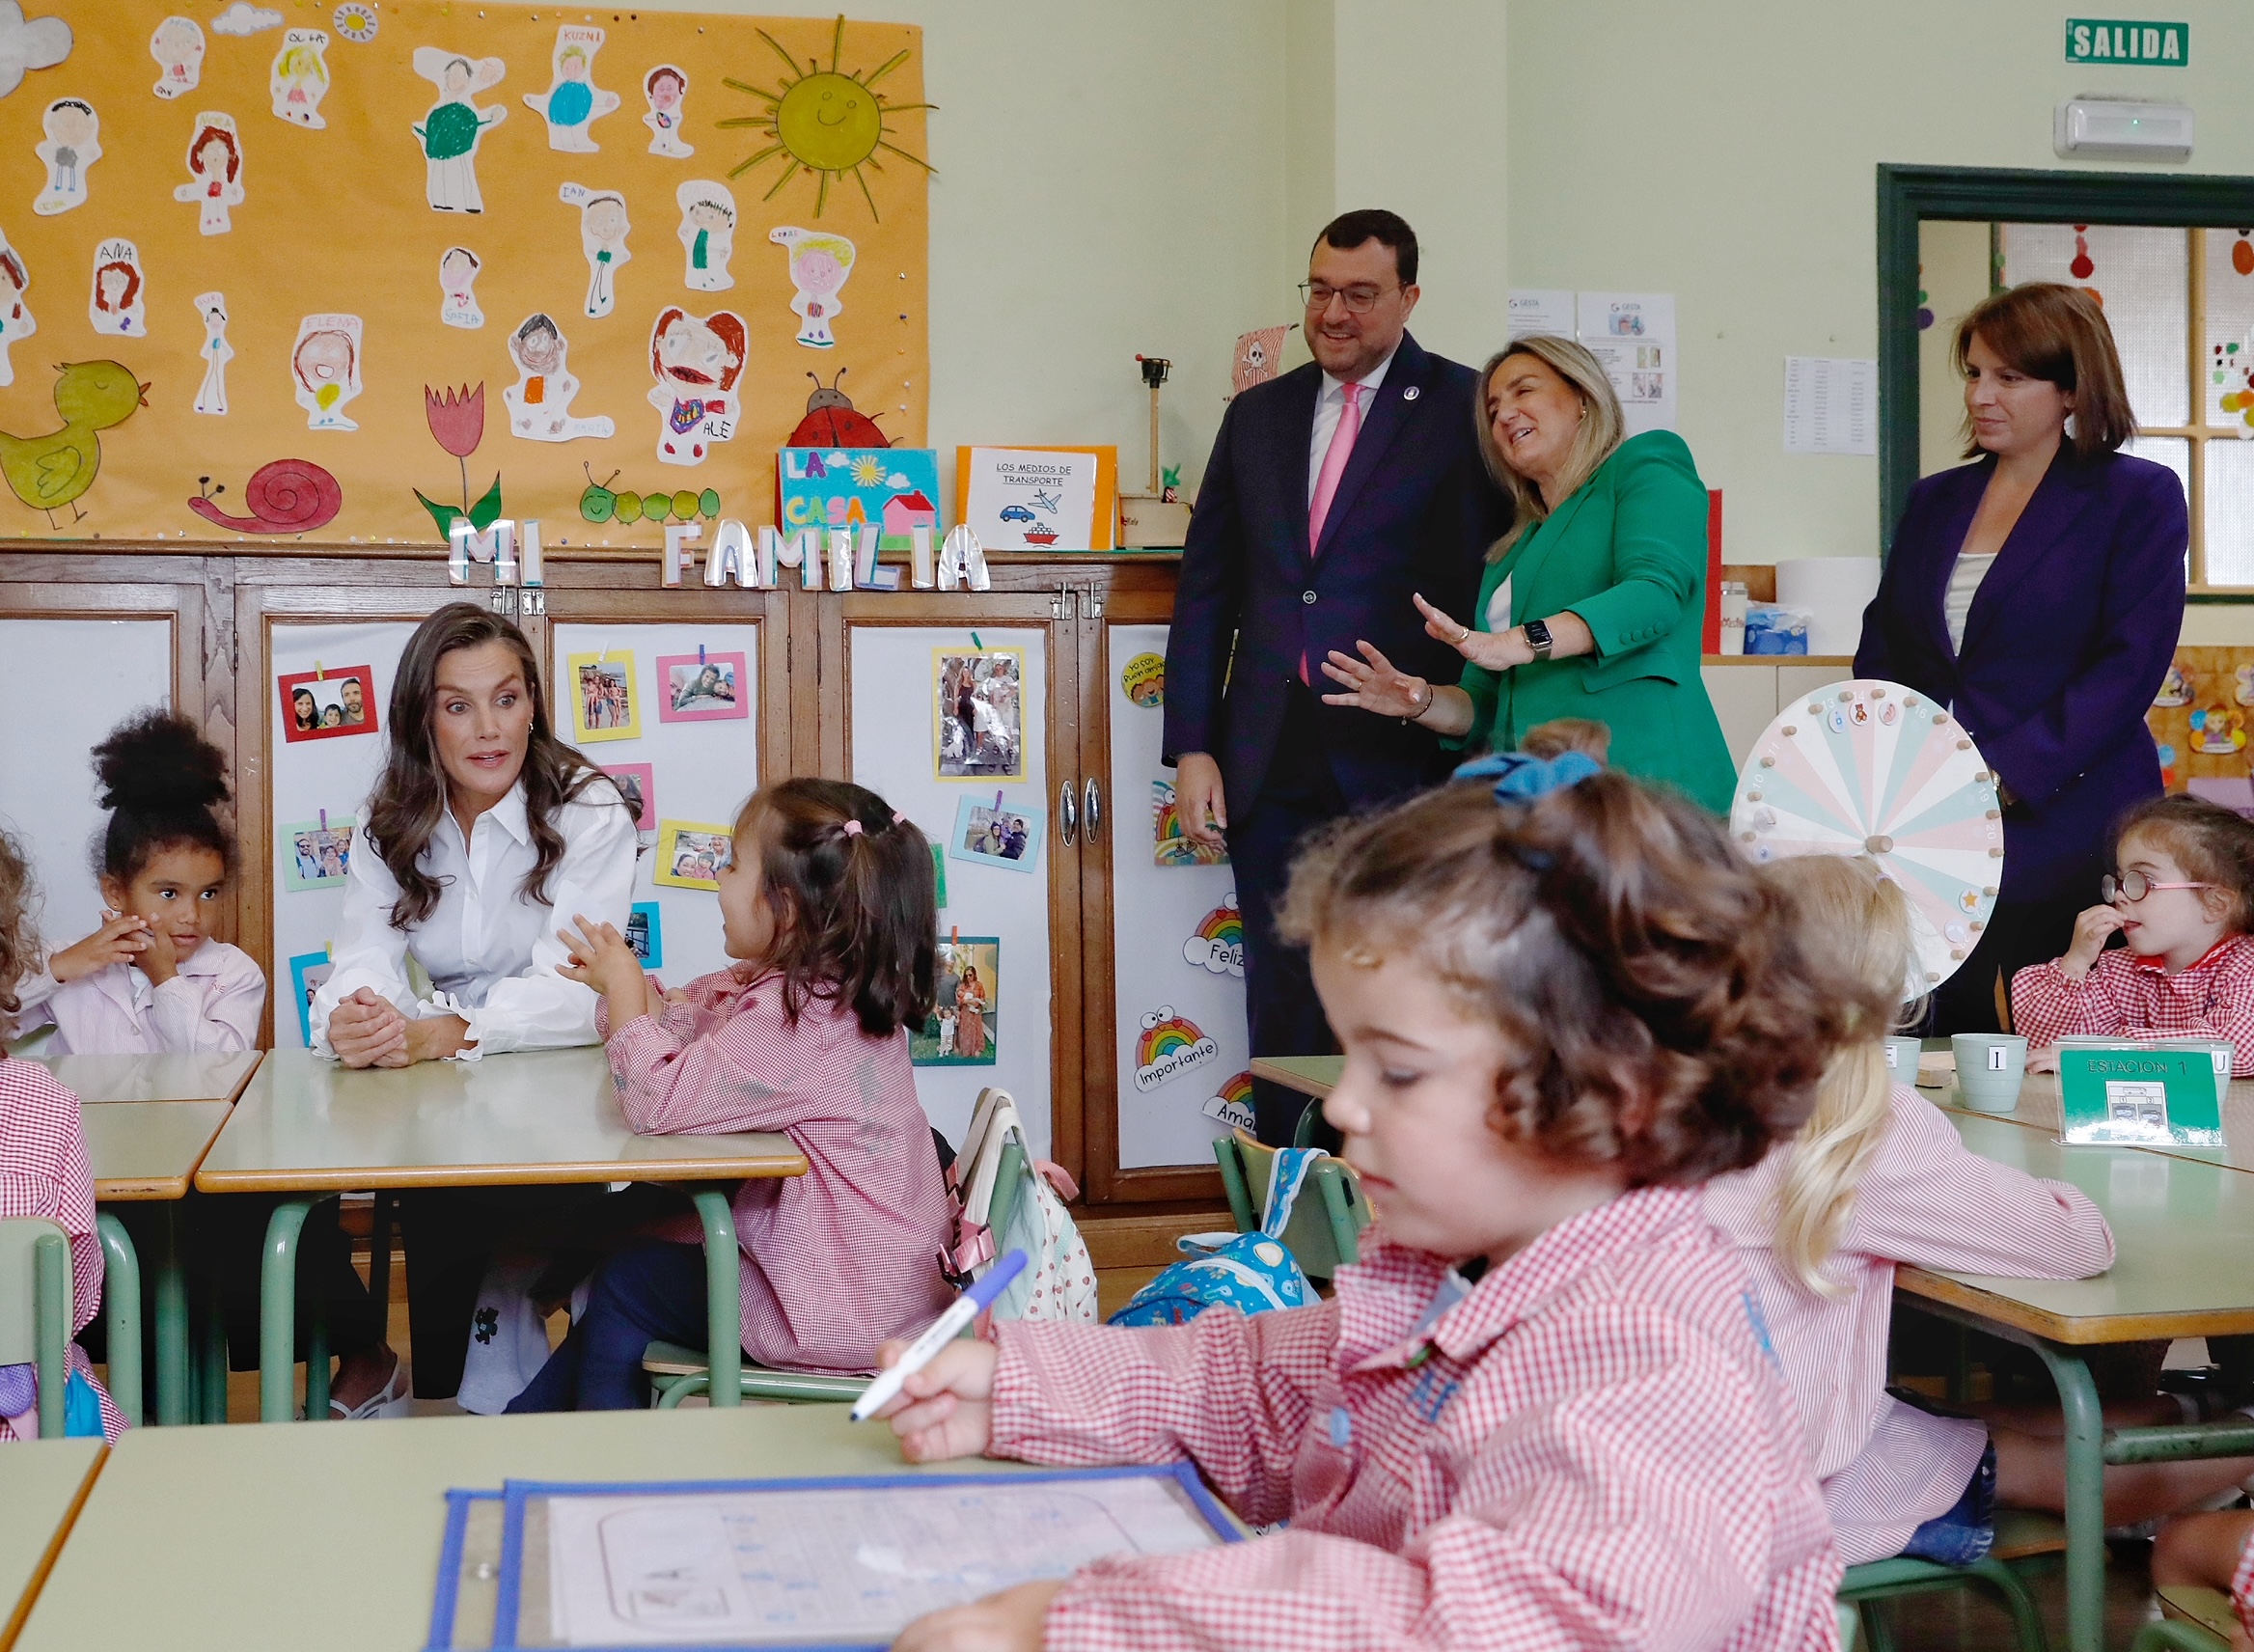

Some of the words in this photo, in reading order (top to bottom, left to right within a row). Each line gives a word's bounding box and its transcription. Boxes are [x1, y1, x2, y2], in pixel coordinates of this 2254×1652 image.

[2074, 24, 2181, 61] SALIDA
[563, 185, 586, 198] IAN
[99, 243, 134, 261] ANA
[445, 308, 481, 324] SOFIA
[702, 422, 731, 439] ALE
[785, 452, 827, 479] LA
[996, 463, 1015, 472] LOS
[1018, 463, 1056, 473] MEDIOS
[1059, 465, 1072, 475] DE
[1003, 475, 1063, 486] TRANSPORTE
[786, 495, 866, 525] CASA
[448, 516, 545, 588] MI
[661, 517, 991, 592] FAMILIA
[1853, 690, 1865, 702] 14
[1822, 698, 1835, 712] 13
[1914, 704, 1928, 720] 16
[1943, 726, 1958, 741] 17
[1752, 773, 1765, 789] 10
[1977, 786, 1990, 803] 19
[1985, 824, 1996, 840] 20
[1210, 944, 1245, 967] Feliz
[1140, 1043, 1214, 1086] Importante
[2087, 1059, 2169, 1074] ESTACIÓN
[2178, 1060, 2187, 1076] 1
[1217, 1103, 1256, 1131] Ama
